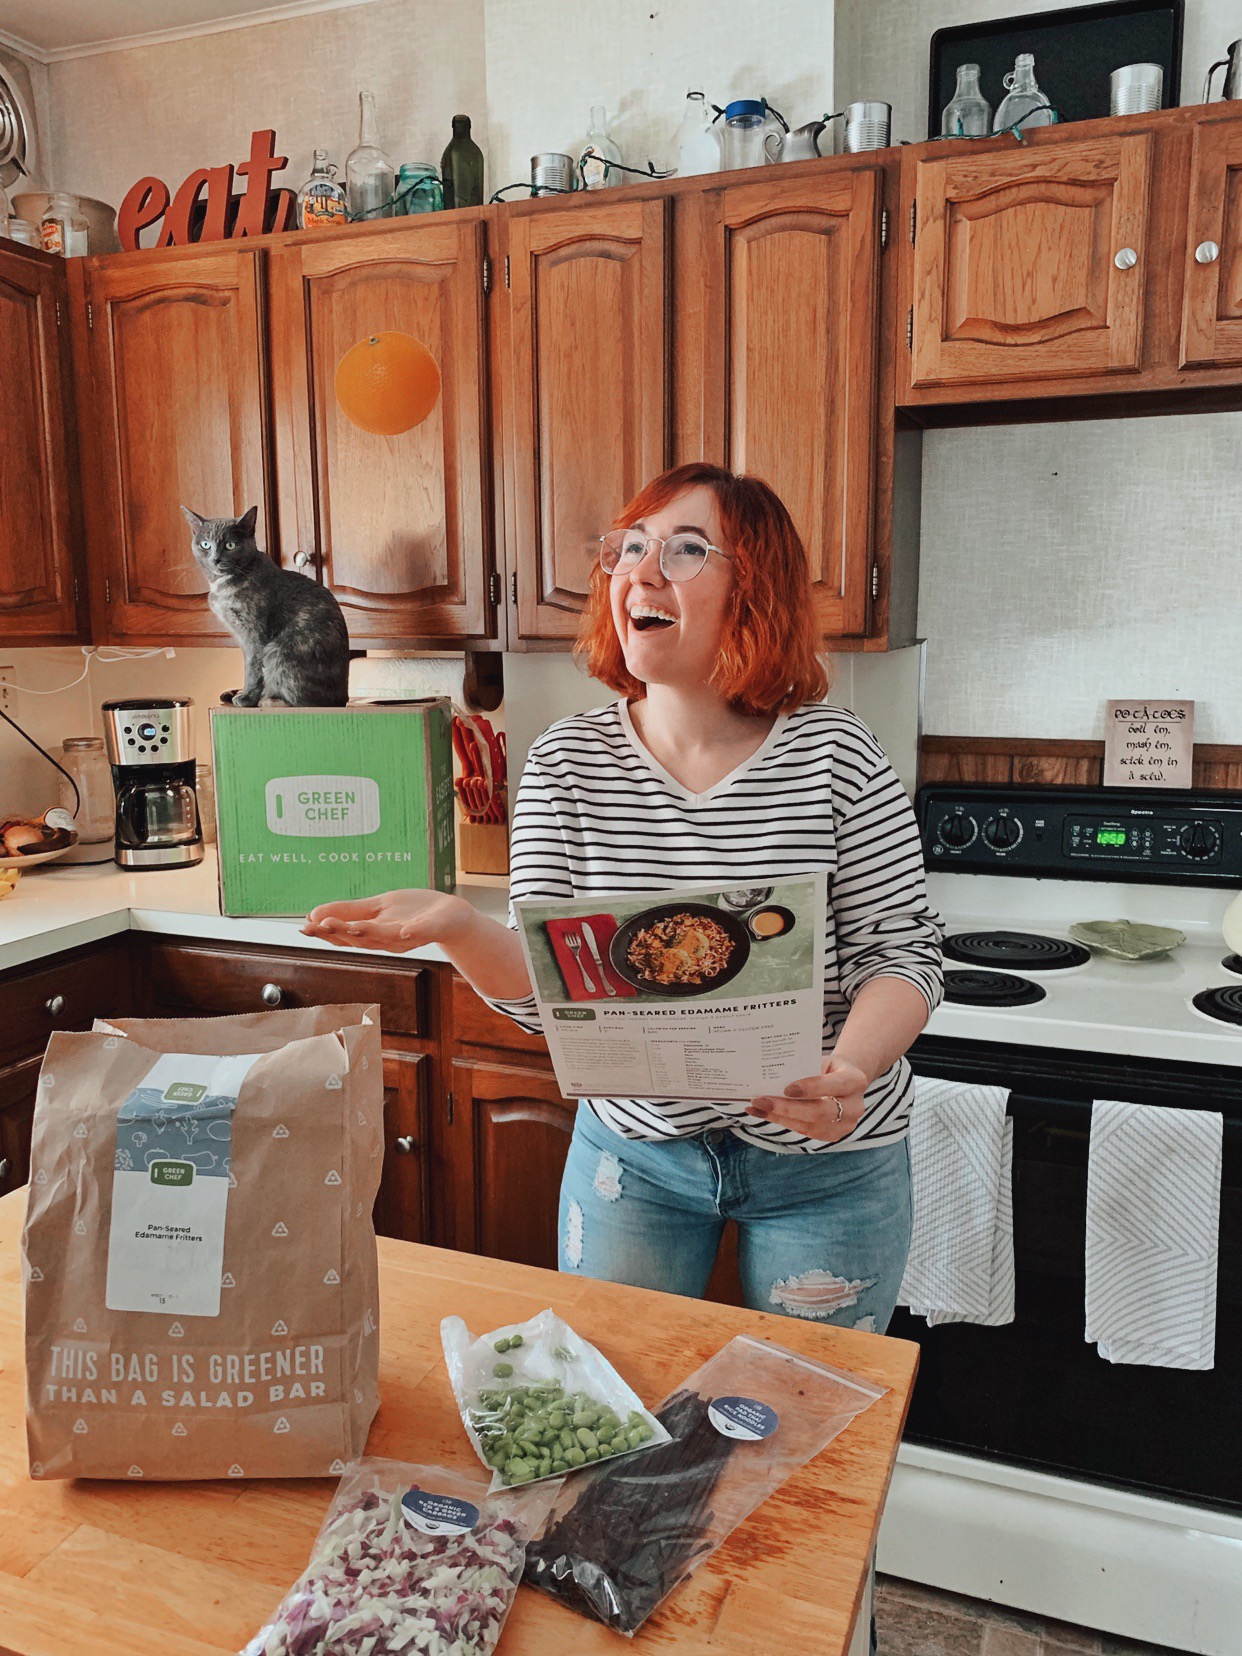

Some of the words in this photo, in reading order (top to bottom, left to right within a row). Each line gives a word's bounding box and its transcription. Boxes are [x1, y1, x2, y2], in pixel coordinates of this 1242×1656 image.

[118, 129, 289, 252] eat
[297, 792, 356, 804] GREEN
[304, 807, 350, 821] CHEF
[239, 853, 264, 863] EAT
[270, 853, 313, 864] WELL,
[318, 852, 360, 862] COOK
[365, 852, 412, 862] OFTEN
[681, 1006, 739, 1015] EDAMAME
[743, 999, 797, 1011] FRITTERS
[148, 1224, 191, 1233] Pan-Seared
[135, 1231, 174, 1240] Edamame
[175, 1234, 203, 1242] Fritters
[50, 1345, 98, 1380] THIS
[110, 1353, 158, 1383] BAG
[172, 1354, 195, 1383] IS
[209, 1345, 325, 1384] GREENER
[47, 1385, 117, 1404] THAN
[130, 1389, 147, 1405] A
[161, 1389, 254, 1408] SALAD
[269, 1381, 326, 1402] BAR
